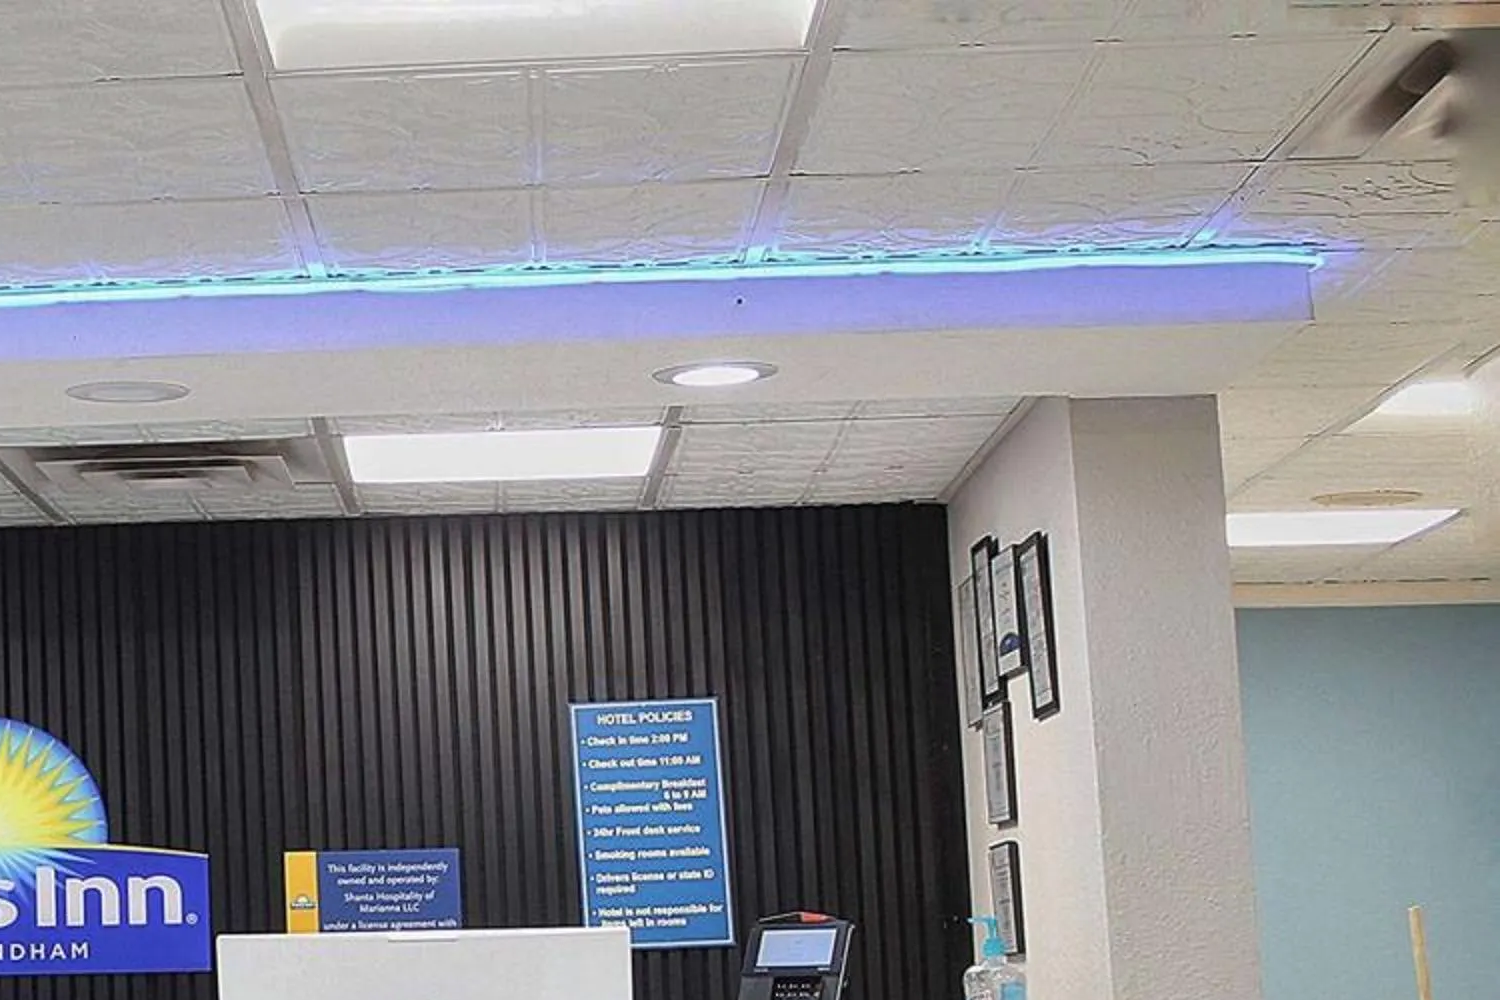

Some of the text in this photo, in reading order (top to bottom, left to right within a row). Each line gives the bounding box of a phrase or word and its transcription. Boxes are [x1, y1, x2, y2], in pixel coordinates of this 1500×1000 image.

[597, 710, 693, 725] HOTEL POLICIES
[587, 737, 617, 746] Check
[618, 735, 628, 745] in
[629, 734, 650, 744] time
[672, 732, 688, 742] PM
[588, 759, 619, 769] Check
[620, 758, 636, 768] out
[637, 757, 658, 768] time
[685, 754, 701, 766] AM
[590, 778, 707, 792] Complimentary Breakfast
[672, 789, 683, 799] to
[691, 788, 708, 799] AM
[592, 801, 693, 814] Pets allowed with fees
[615, 826, 641, 836] Front
[642, 824, 666, 835] desk
[667, 823, 701, 834] service
[595, 846, 711, 861] Smoking rooms available
[326, 861, 449, 874] This facility is independently
[337, 876, 366, 886] owned
[367, 875, 385, 885] and
[386, 874, 425, 886] operated
[596, 867, 715, 883] Drivers license or state ID
[36, 865, 183, 927] Inn
[376, 890, 424, 903] Hospitality
[425, 889, 436, 900] of
[596, 883, 636, 895] required
[402, 902, 421, 913] LLC
[598, 902, 724, 918] Hotel is not responsible for
[324, 921, 349, 932] under
[358, 920, 389, 931] license
[390, 920, 437, 932] agreement
[438, 918, 457, 929] with
[645, 917, 655, 927] in
[656, 917, 687, 927] rooms
